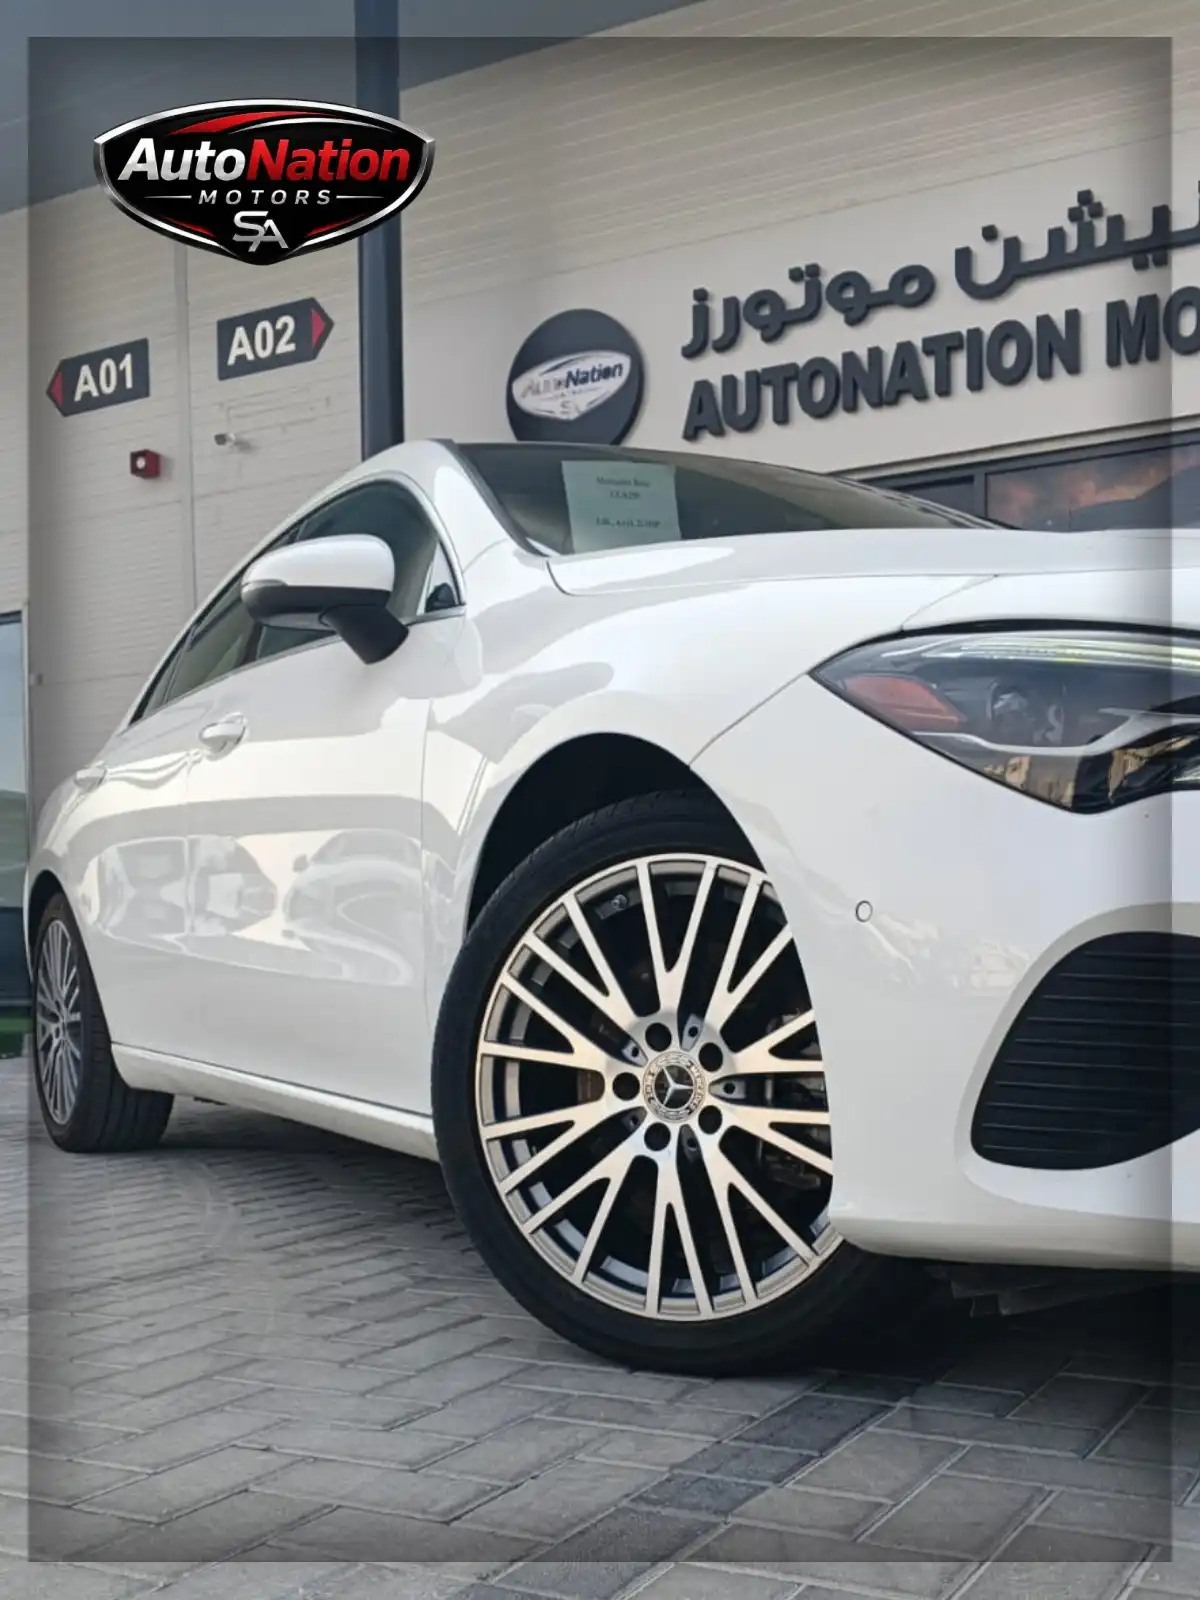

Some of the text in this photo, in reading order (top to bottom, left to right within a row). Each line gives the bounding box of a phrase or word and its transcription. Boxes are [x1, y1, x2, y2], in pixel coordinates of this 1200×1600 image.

[681, 181, 1200, 359] يشن موتورز
[227, 315, 296, 366] A02
[682, 286, 1200, 441] AUTONATION MO
[74, 353, 133, 402] A01
[521, 363, 623, 399] AuNation
